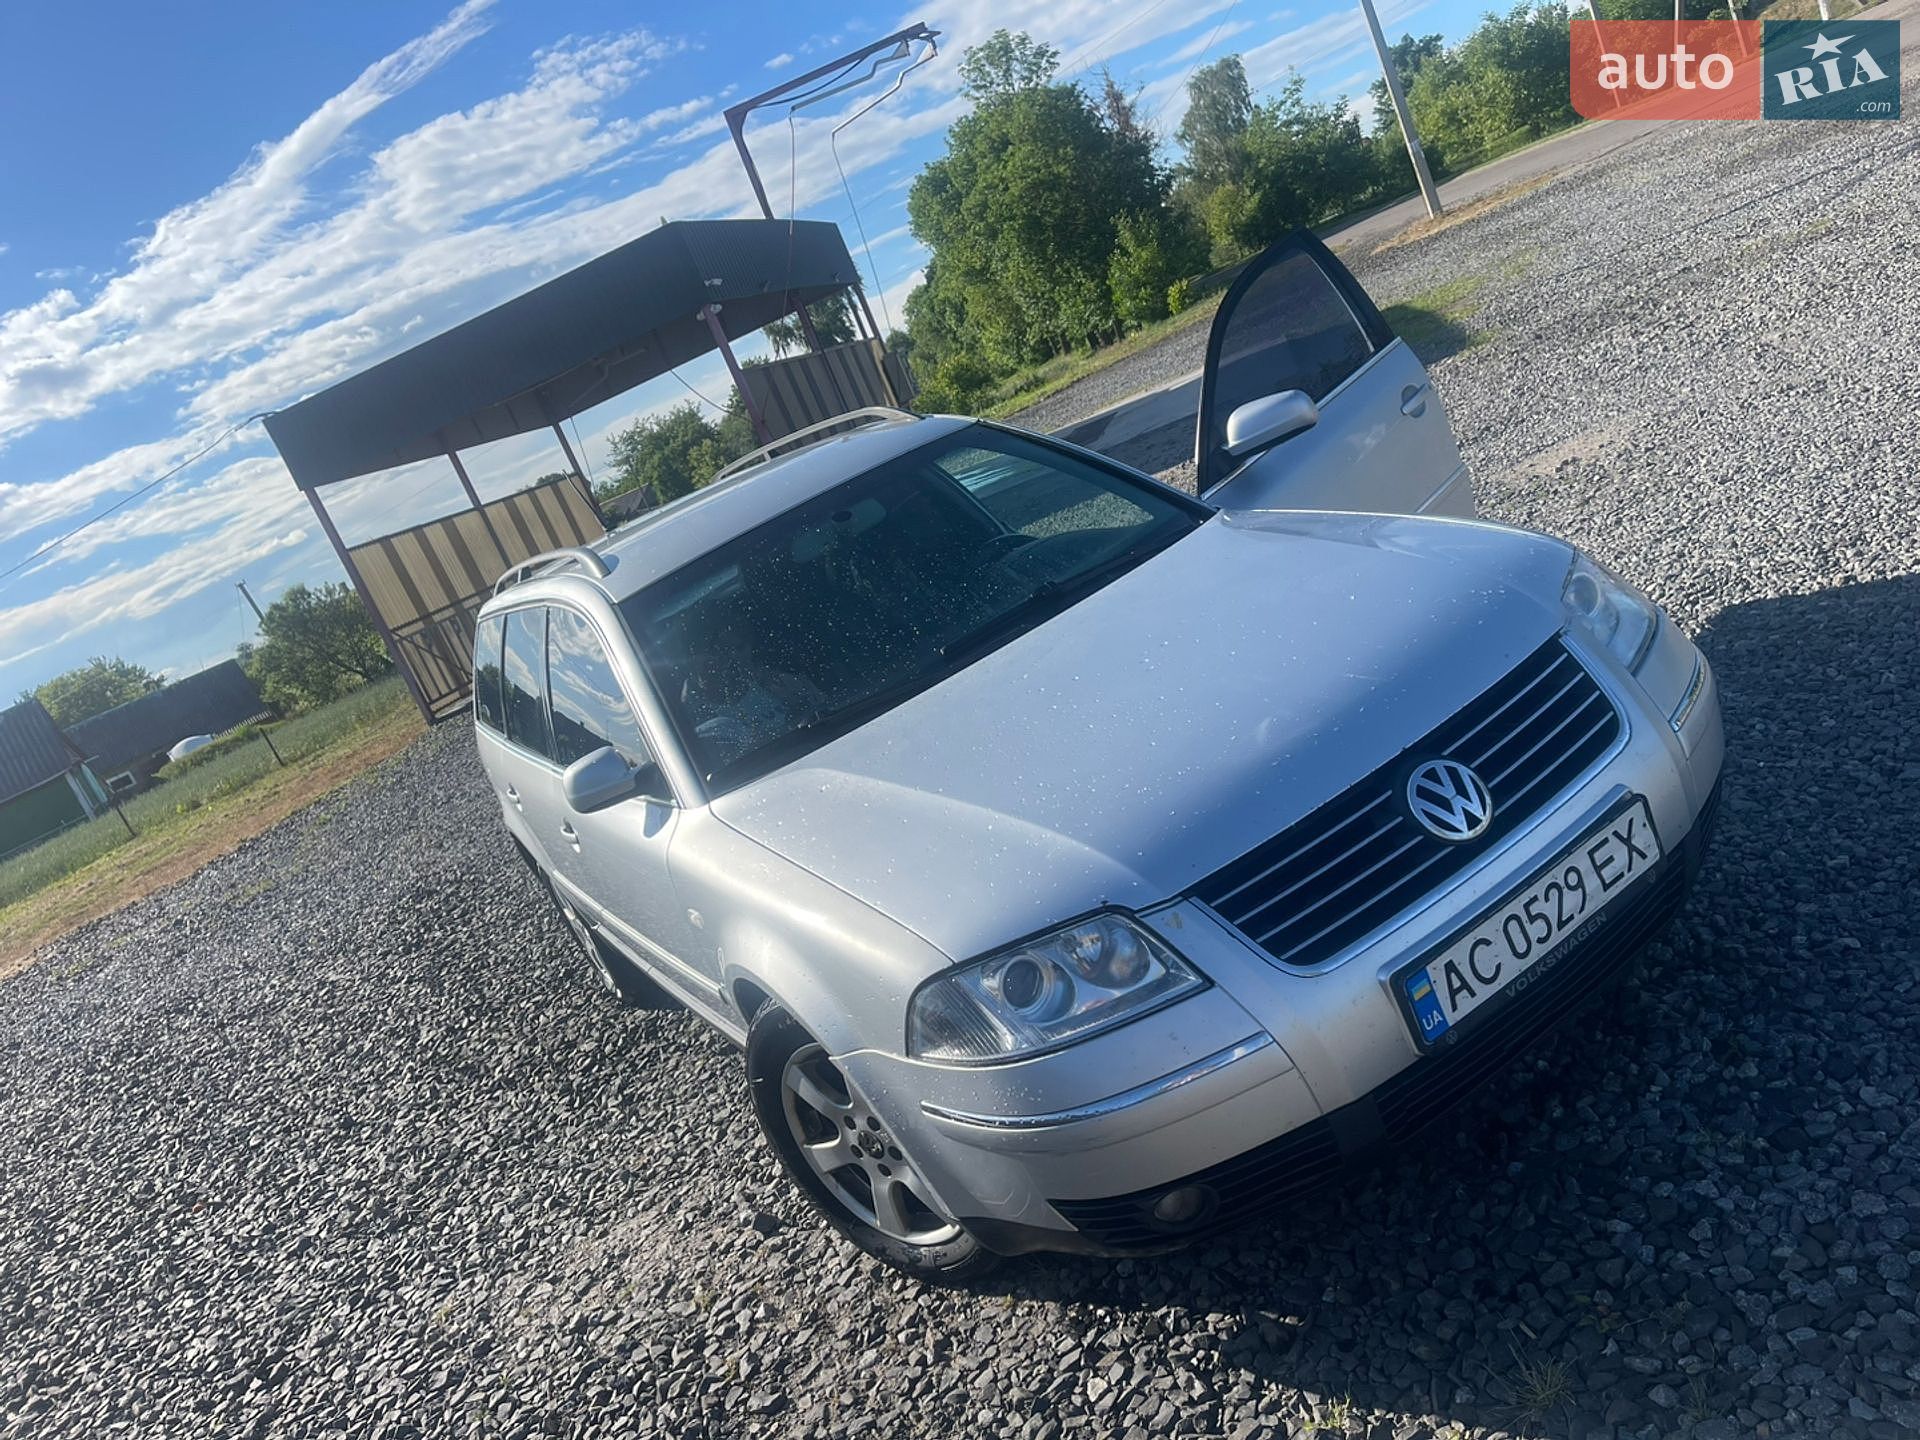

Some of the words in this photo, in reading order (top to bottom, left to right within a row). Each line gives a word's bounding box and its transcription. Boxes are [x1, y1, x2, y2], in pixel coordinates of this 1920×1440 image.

[1443, 937, 1502, 1013] AC
[1502, 865, 1588, 960] 0529
[1587, 817, 1648, 892] EX
[1506, 912, 1608, 998] VOLKSWAGEN
[1422, 1009, 1444, 1031] UA
